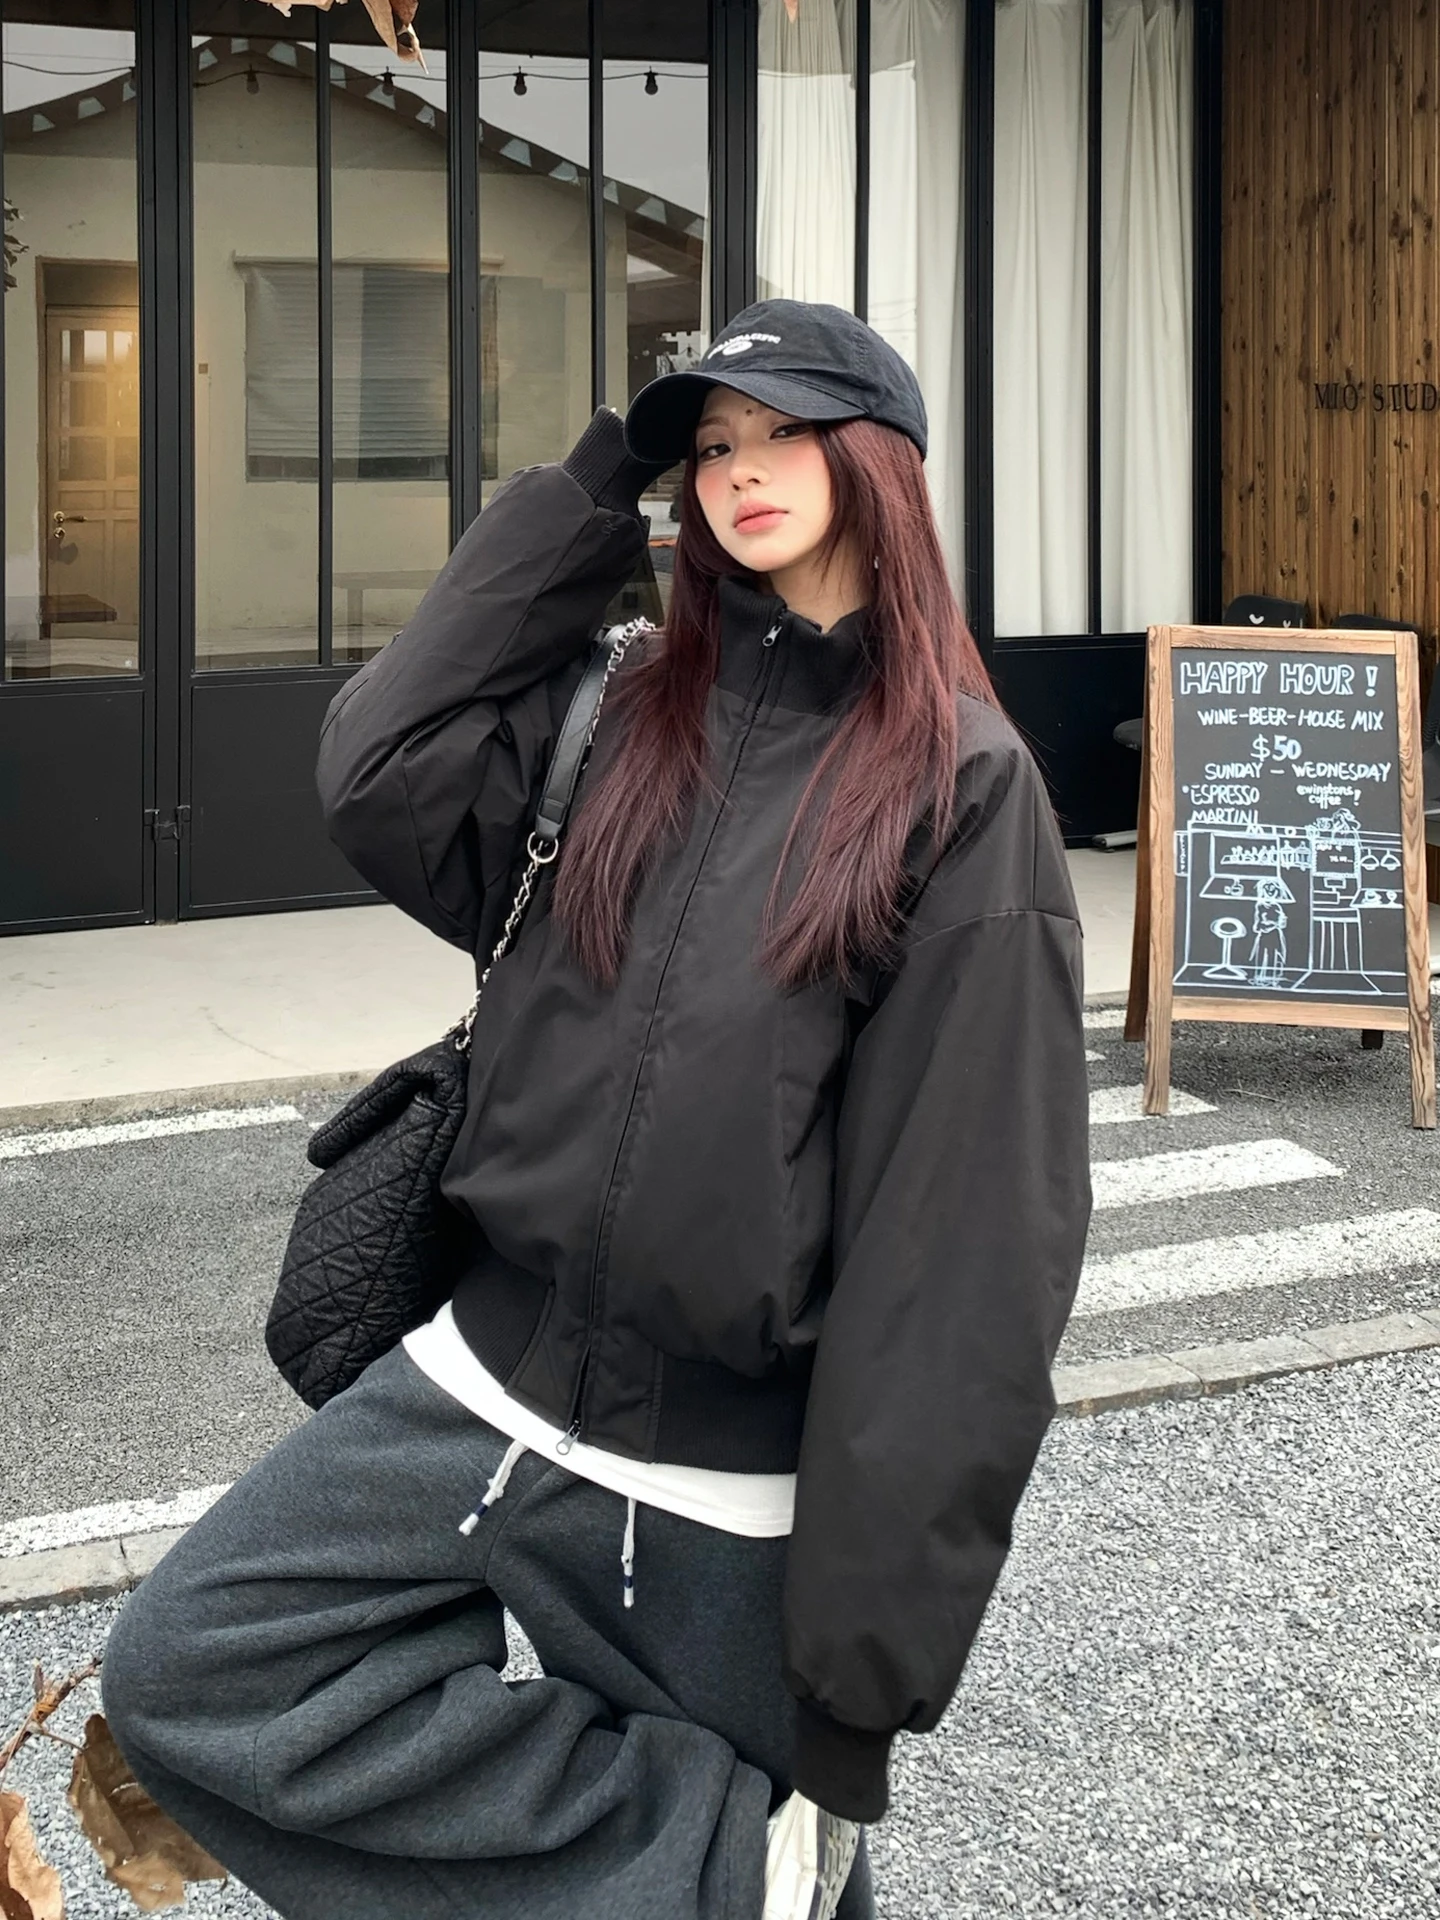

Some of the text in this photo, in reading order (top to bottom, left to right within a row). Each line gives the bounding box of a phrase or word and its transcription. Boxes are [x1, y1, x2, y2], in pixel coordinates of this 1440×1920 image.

[1373, 382, 1440, 412] STUD
[1180, 662, 1379, 697] HAPPY HOUR !
[1351, 710, 1384, 732] MIX
[1250, 734, 1302, 762] $50
[1204, 762, 1263, 781] SUNDAY
[1291, 762, 1392, 783] WEDNESDAY
[1190, 784, 1260, 805] ESPRESSO
[1190, 808, 1259, 825] MARTINI
